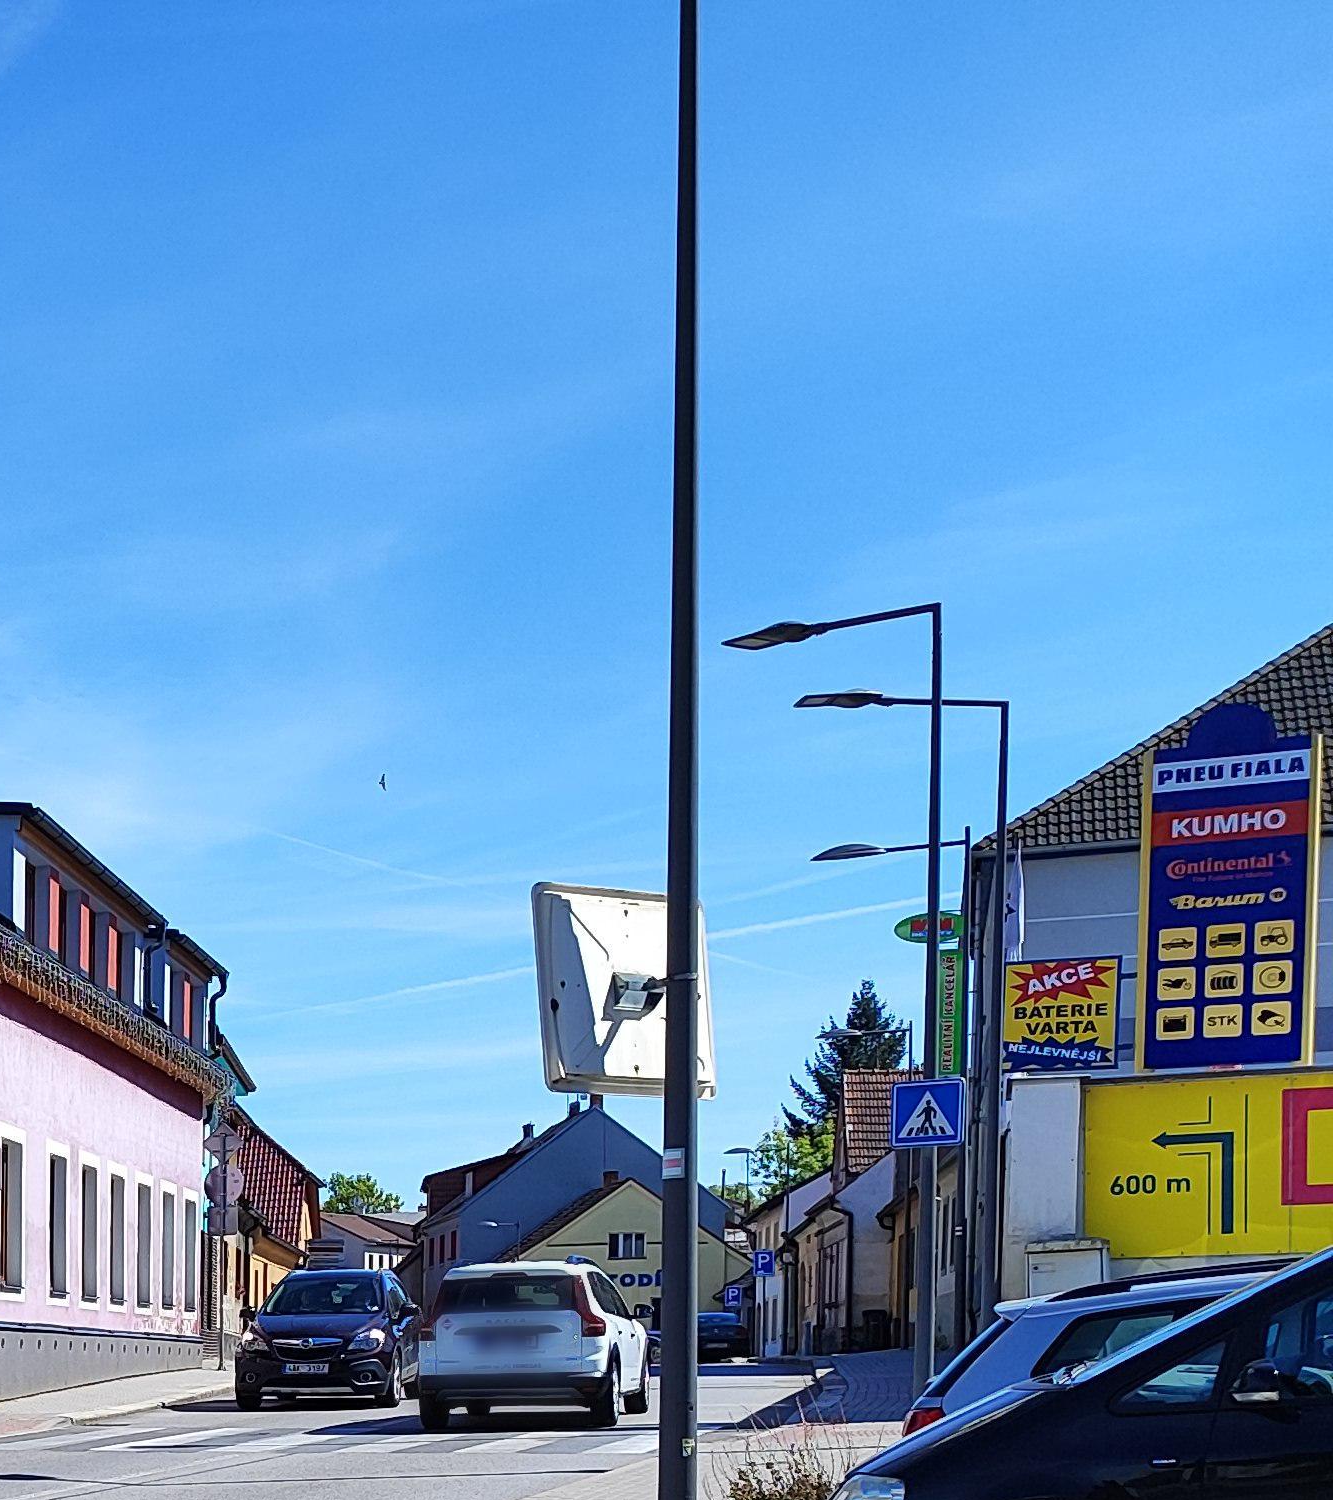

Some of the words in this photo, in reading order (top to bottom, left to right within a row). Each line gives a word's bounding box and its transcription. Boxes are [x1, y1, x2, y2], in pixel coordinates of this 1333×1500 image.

[1158, 764, 1224, 786] PNEU
[1231, 756, 1305, 778] FIALA
[1171, 808, 1287, 838] KUMHO
[1166, 852, 1273, 879] Continental
[1170, 892, 1266, 910] Barum
[1027, 963, 1095, 996] AKCE
[1014, 1003, 1109, 1020] BATERIE
[1207, 1015, 1237, 1026] STK
[1025, 1020, 1098, 1036] VARTA
[1109, 1174, 1156, 1196] 600
[1166, 1177, 1191, 1193] m
[758, 1253, 770, 1268] P
